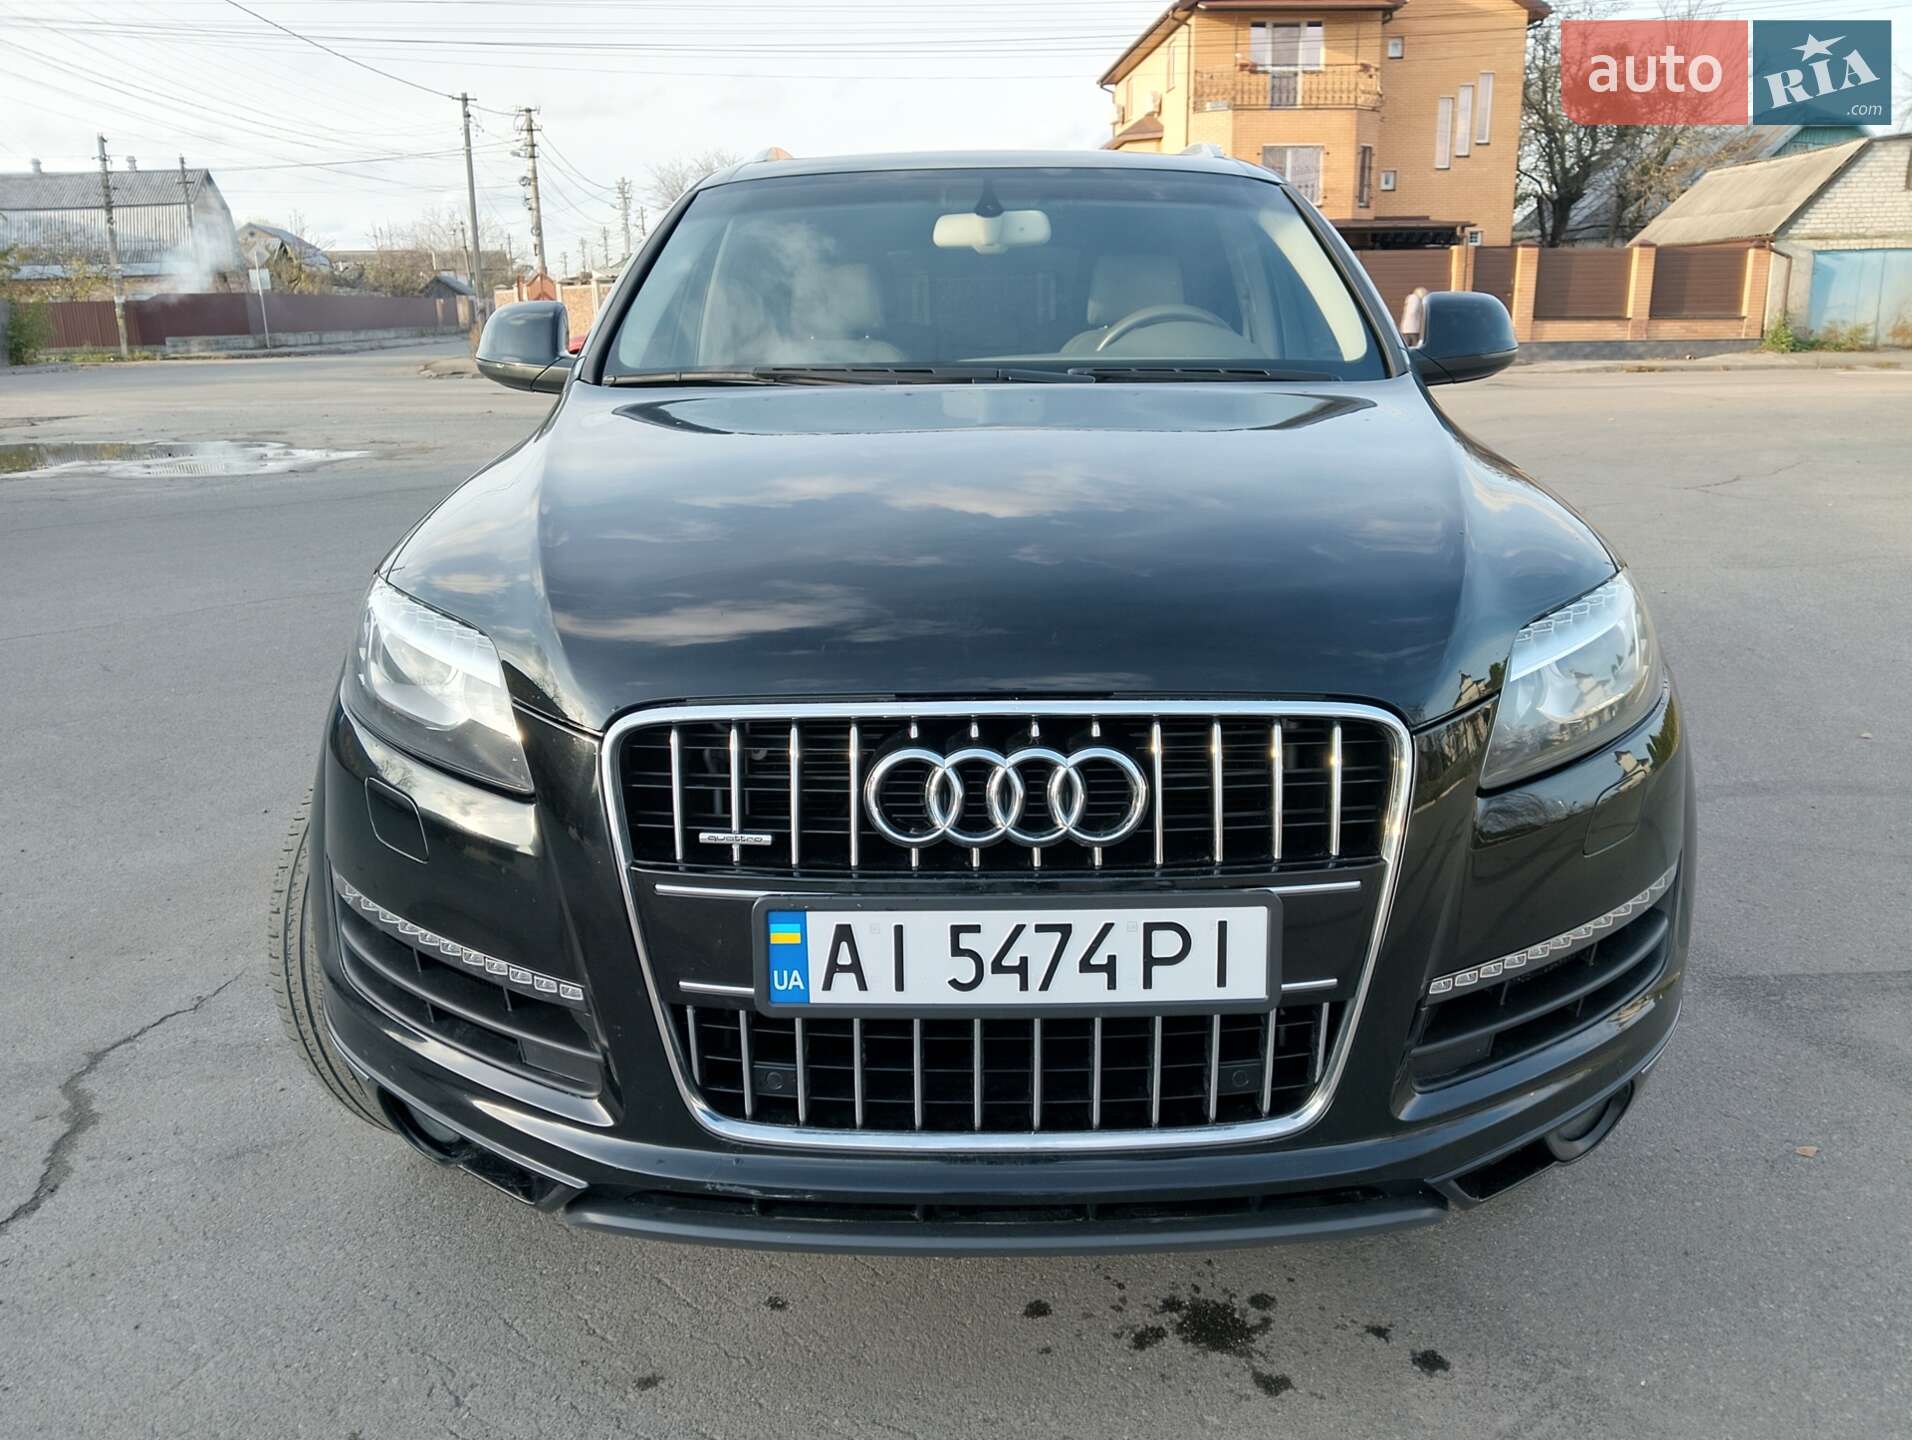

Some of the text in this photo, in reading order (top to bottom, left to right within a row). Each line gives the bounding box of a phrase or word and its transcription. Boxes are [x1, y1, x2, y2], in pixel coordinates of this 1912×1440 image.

[707, 834, 763, 843] quattro
[821, 923, 904, 992] AI
[773, 969, 804, 990] UA
